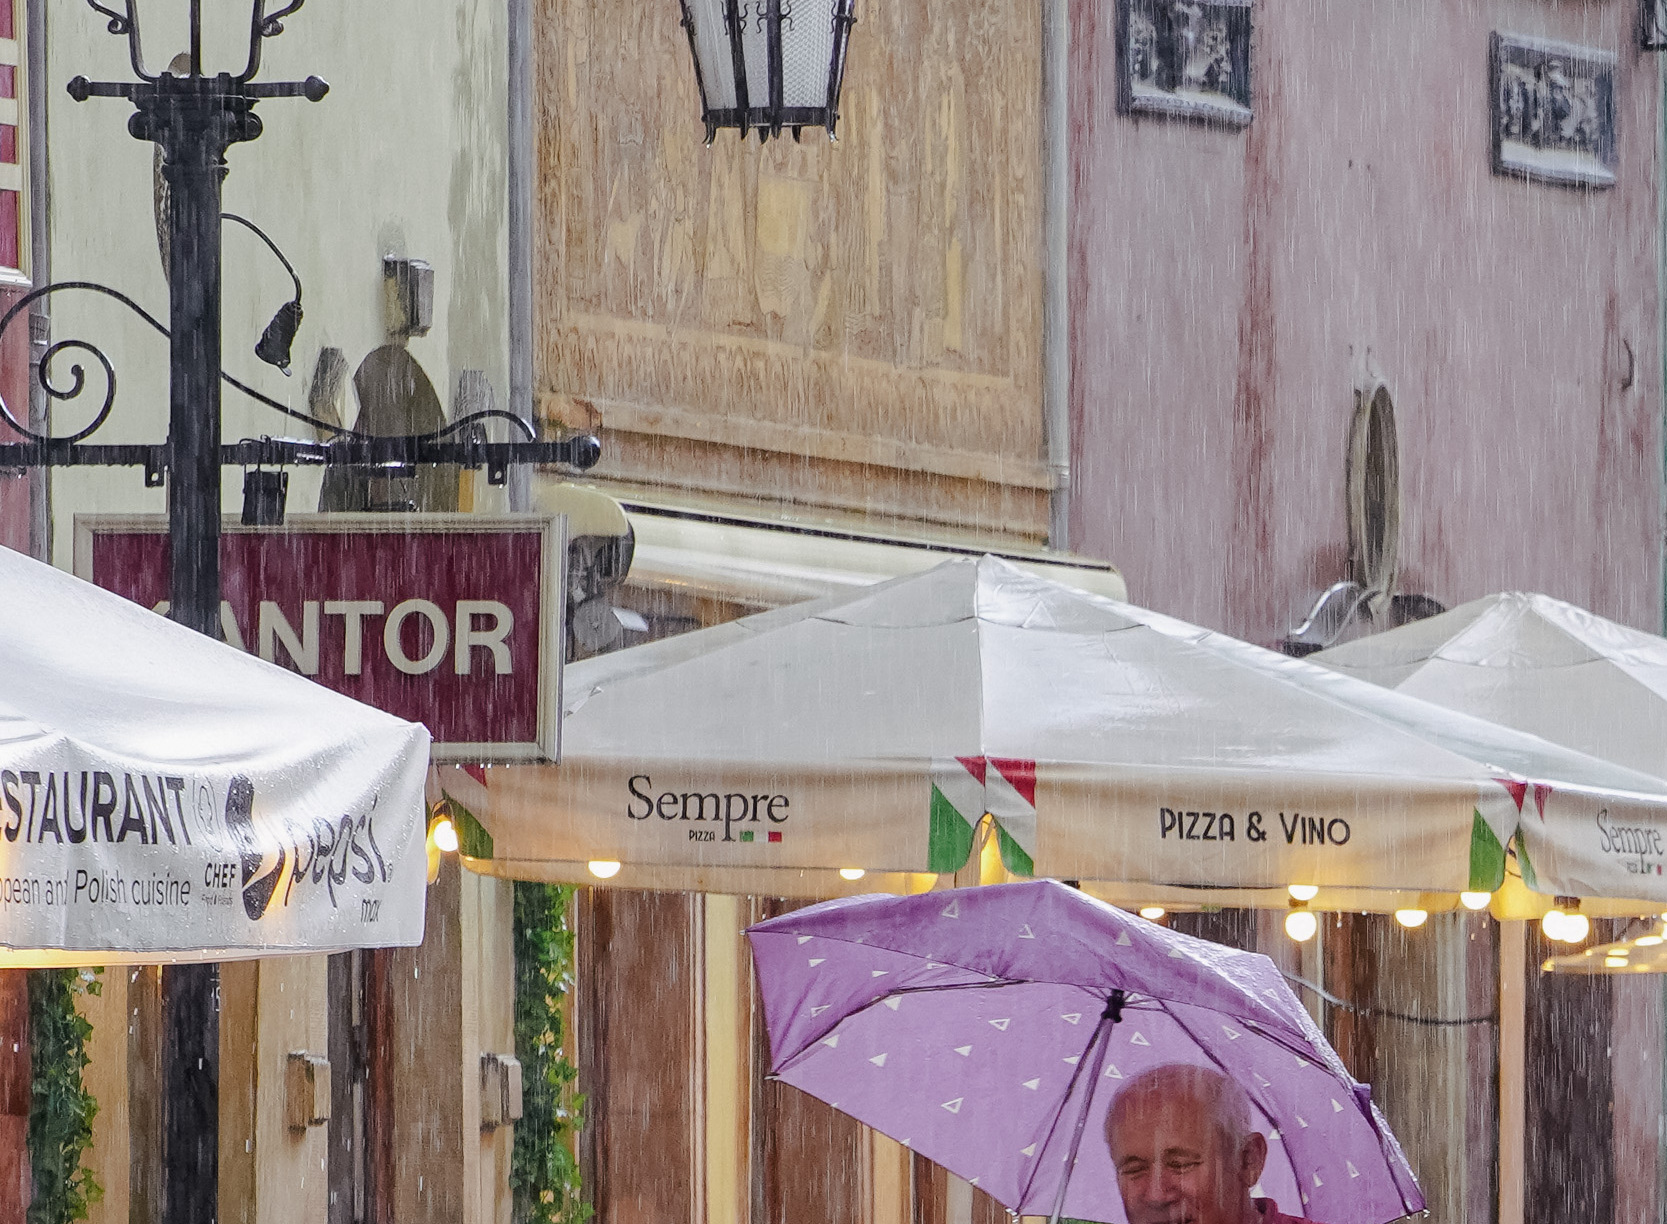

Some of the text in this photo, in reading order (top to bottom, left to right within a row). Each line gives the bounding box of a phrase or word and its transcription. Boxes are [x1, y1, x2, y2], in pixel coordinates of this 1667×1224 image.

[150, 599, 515, 676] NTOR
[0, 769, 192, 845] STAURANT
[627, 774, 790, 843] Sempre
[1160, 807, 1351, 846] PIZZA & VINO
[688, 829, 716, 843] PIZZA
[1596, 808, 1665, 875] Sempre
[0, 877, 41, 912] pean
[74, 869, 127, 904] Polish
[131, 872, 192, 906] cuisine
[204, 862, 237, 888] CHEF
